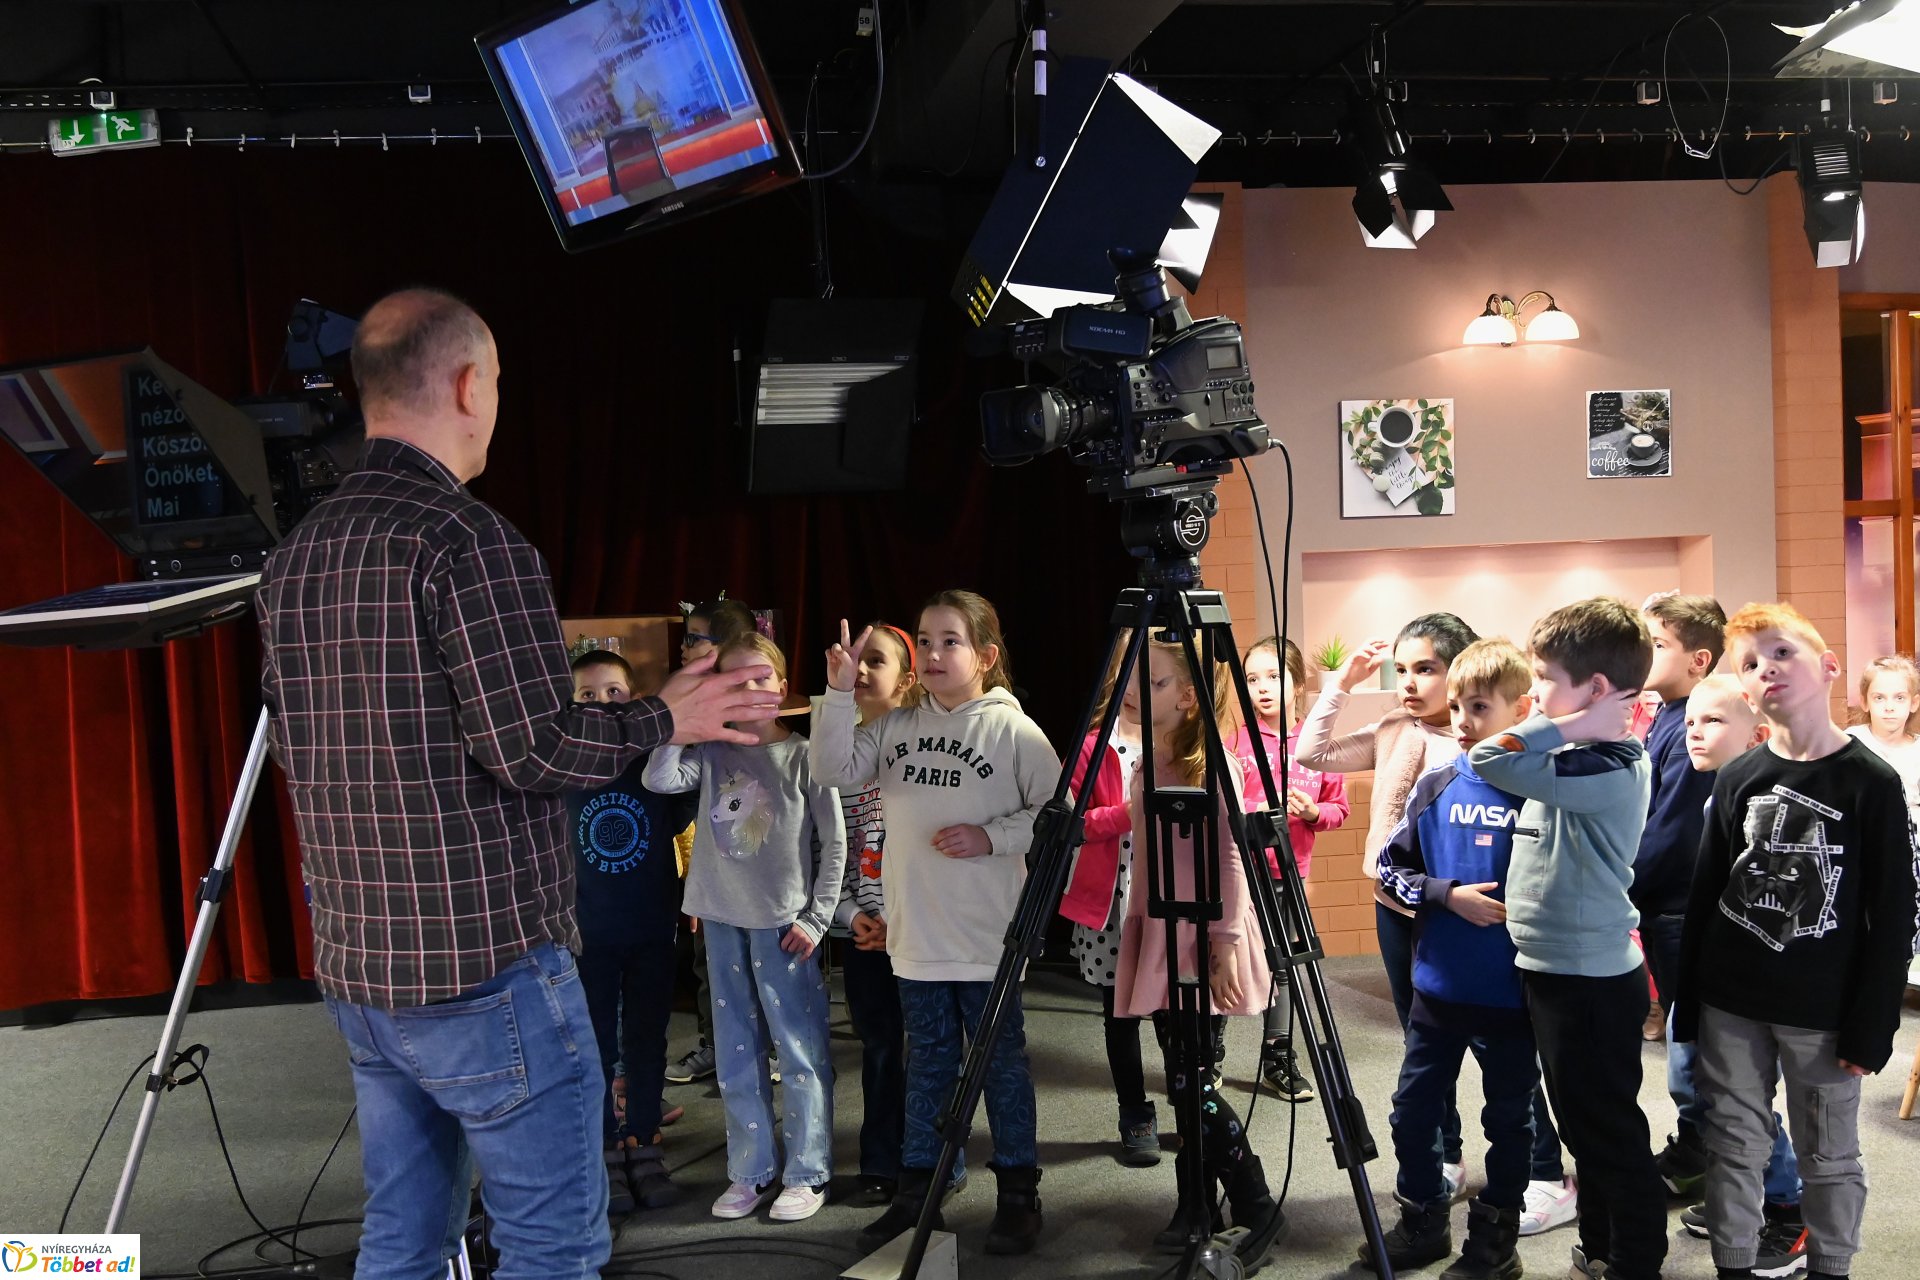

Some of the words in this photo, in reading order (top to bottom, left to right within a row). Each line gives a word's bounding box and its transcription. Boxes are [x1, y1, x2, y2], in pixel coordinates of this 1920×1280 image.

[1591, 450, 1630, 472] coffee
[148, 495, 180, 519] Mai
[917, 737, 994, 779] MARAIS
[902, 765, 962, 788] PARIS
[580, 792, 645, 824] TOGETHER
[1449, 803, 1520, 828] NASA
[599, 820, 632, 847] 92
[583, 846, 597, 864] IS
[598, 839, 649, 873] BETTER
